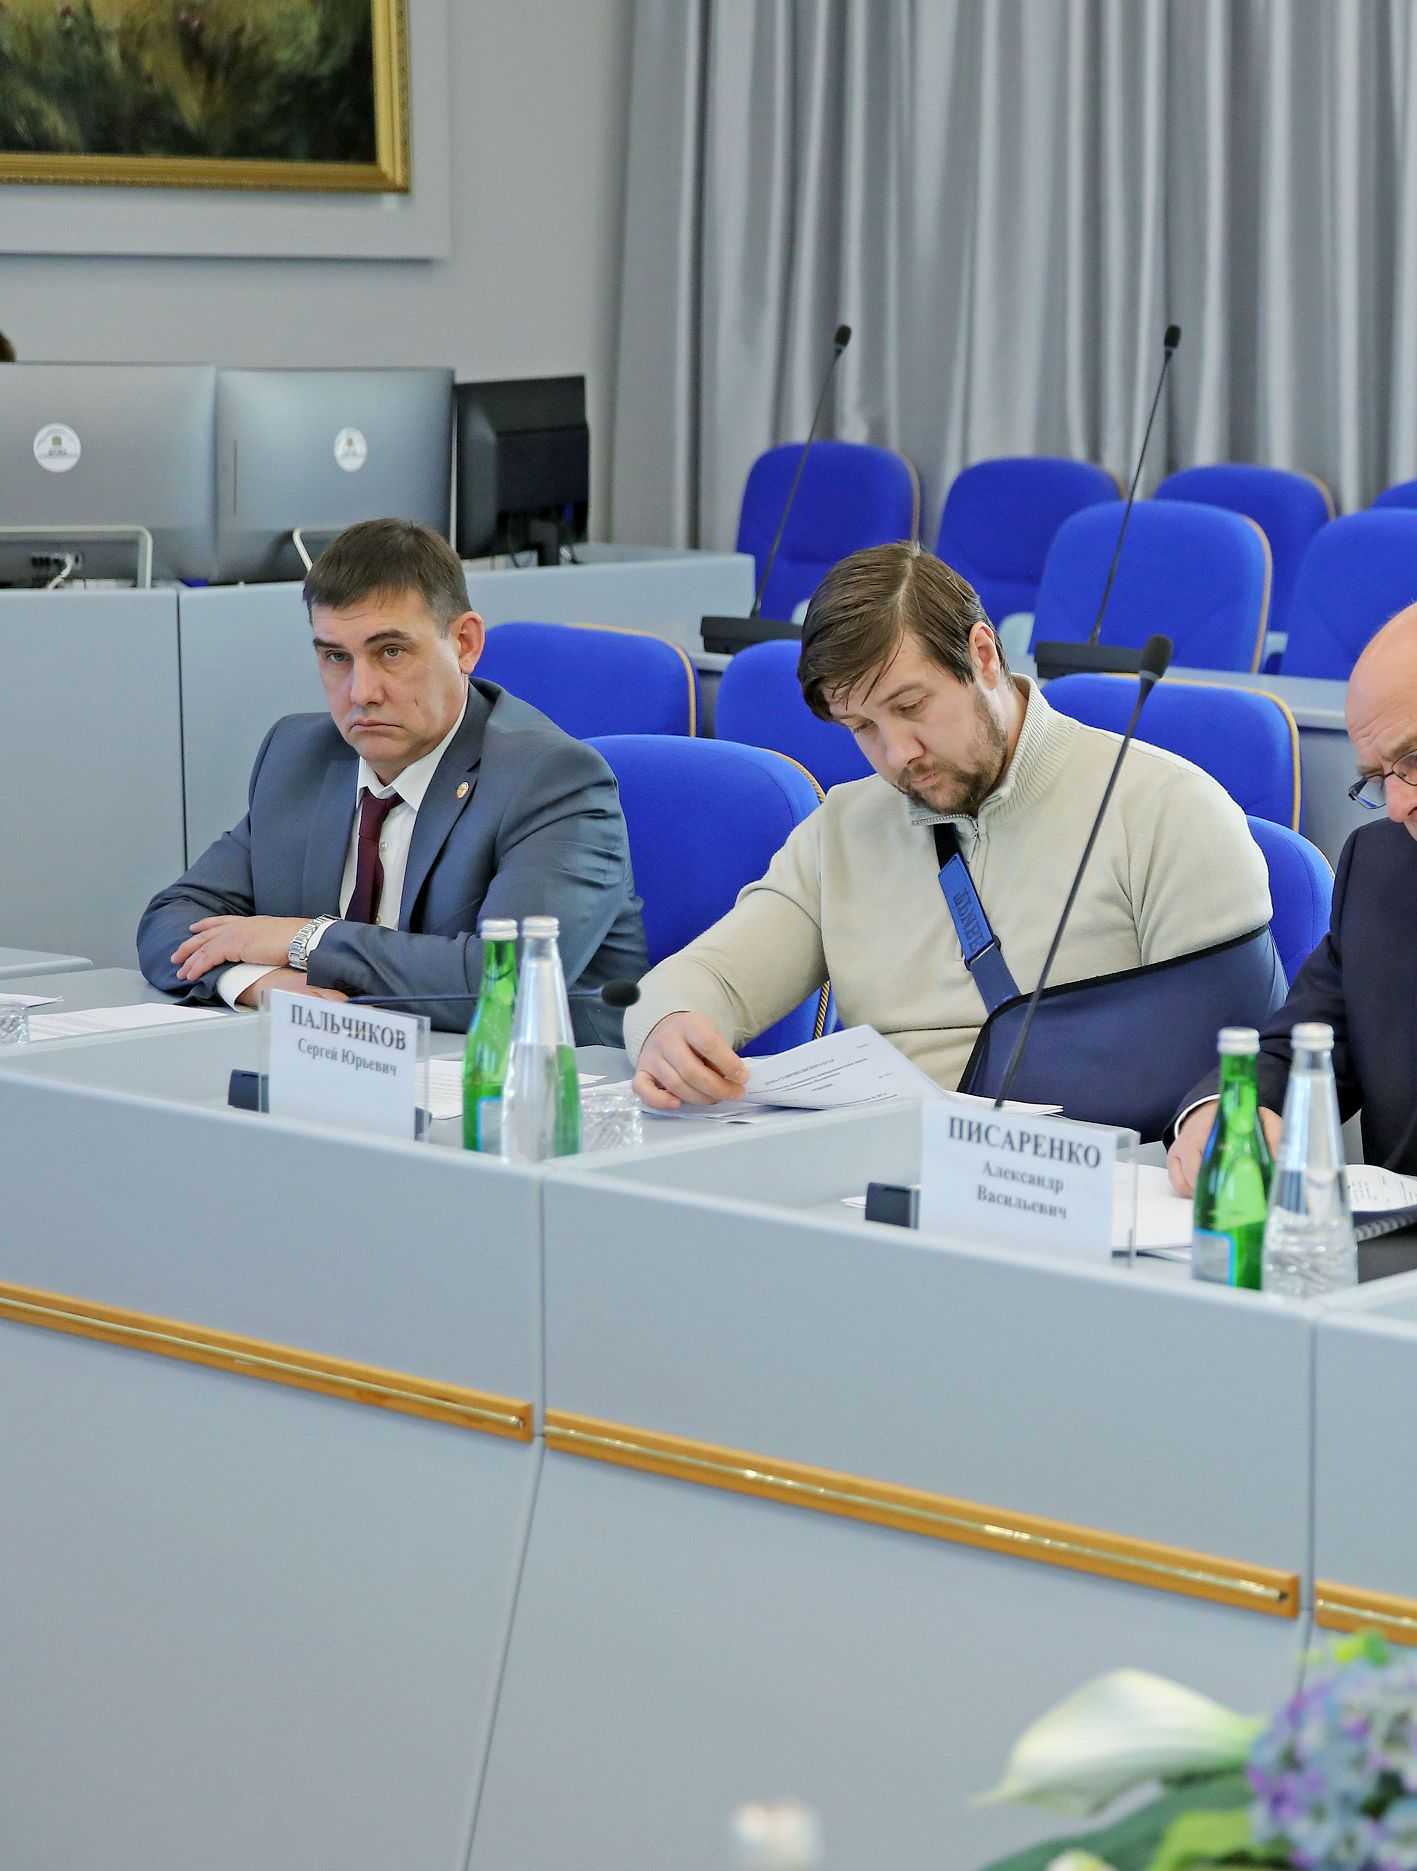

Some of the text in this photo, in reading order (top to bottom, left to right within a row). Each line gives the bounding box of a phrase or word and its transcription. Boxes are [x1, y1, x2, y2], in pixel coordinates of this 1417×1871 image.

[290, 1004, 407, 1051] ПАЛЬЧИКОВ
[298, 1038, 397, 1077] Сергей Юрьевич
[948, 1115, 1102, 1169] ПИСАРЕНКО
[981, 1160, 1065, 1195] Александр
[976, 1184, 1068, 1220] Васильевич
